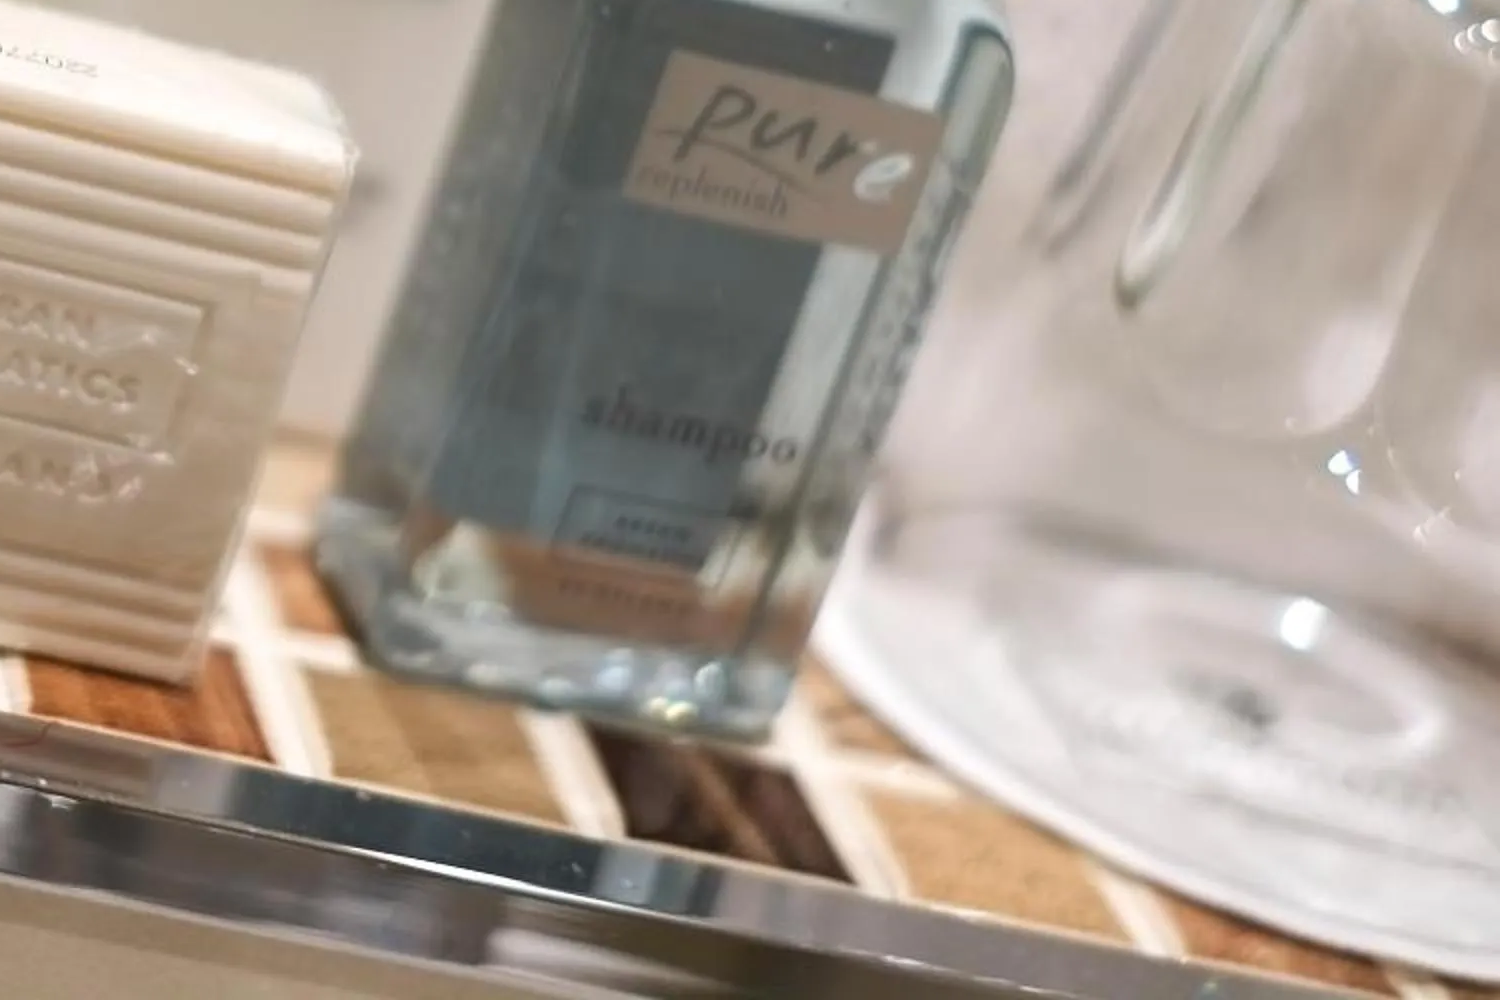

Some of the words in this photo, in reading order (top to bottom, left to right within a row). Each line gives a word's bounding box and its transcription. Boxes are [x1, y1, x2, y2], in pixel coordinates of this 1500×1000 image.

[658, 84, 914, 203] pure
[635, 165, 789, 219] replenish
[581, 384, 797, 467] shampoo
